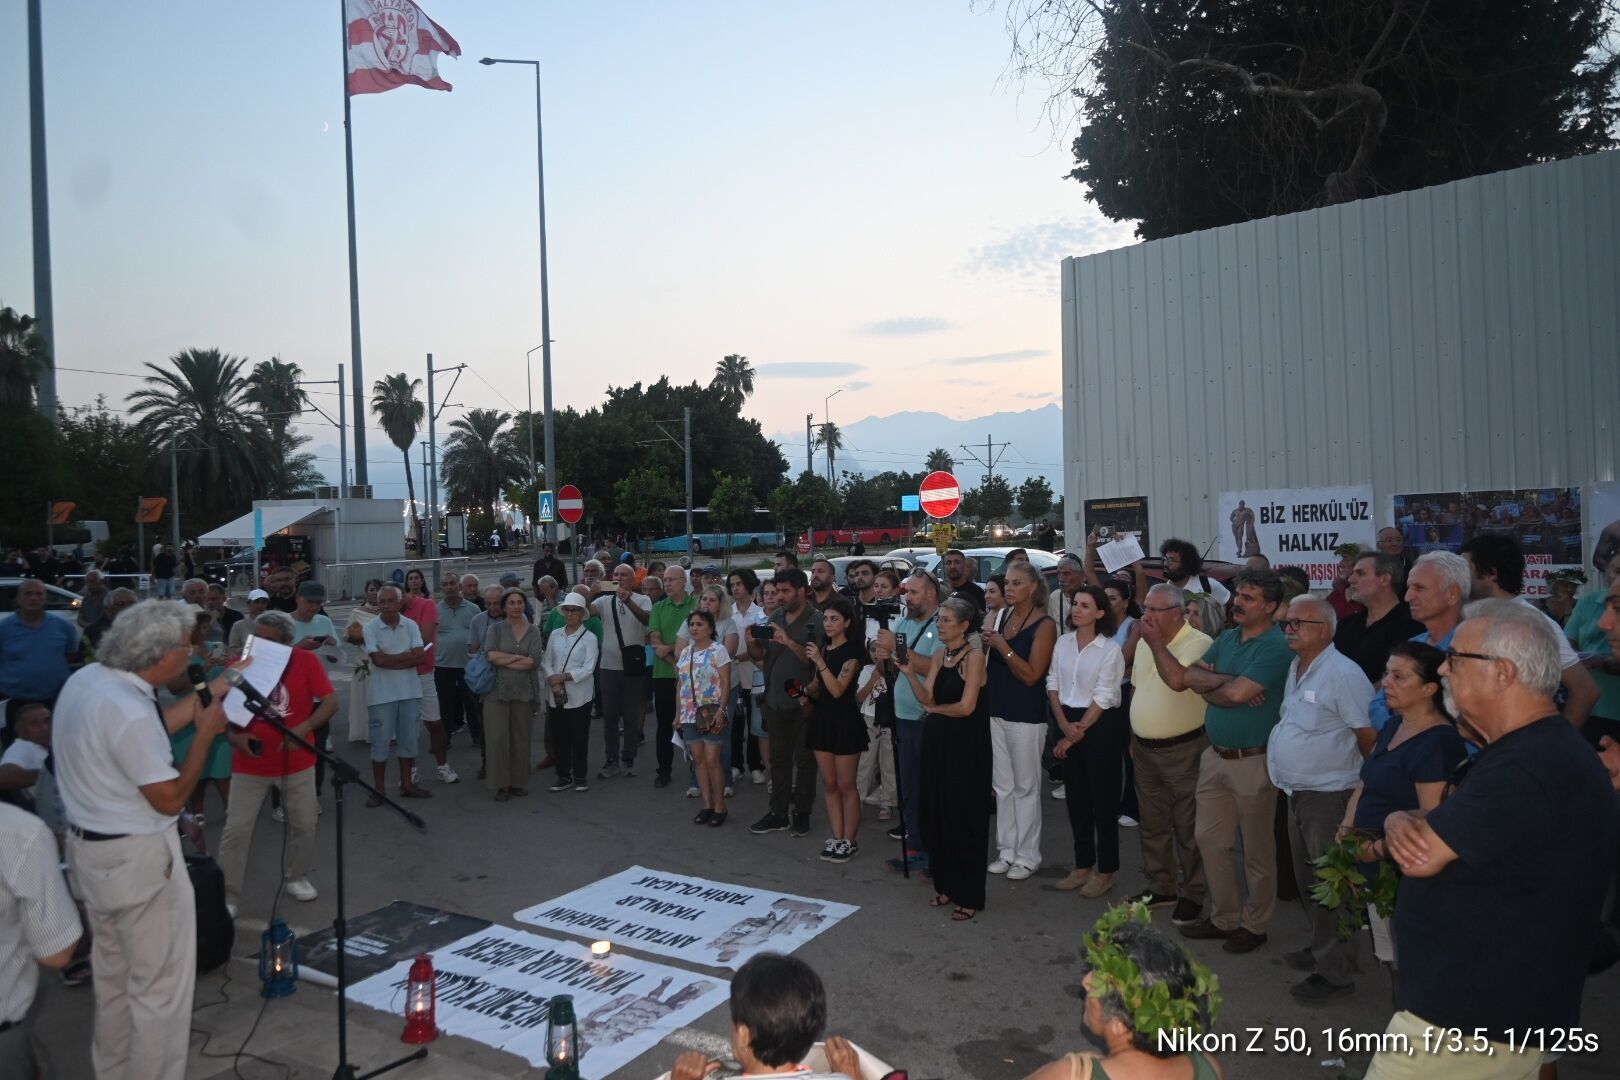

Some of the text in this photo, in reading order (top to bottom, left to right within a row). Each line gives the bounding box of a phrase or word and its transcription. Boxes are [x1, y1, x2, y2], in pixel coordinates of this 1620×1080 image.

[1260, 498, 1369, 524] BİZ HERKÜL'ÜZ
[1278, 532, 1340, 552] HALKIZ
[631, 875, 755, 906] TARİH OLACAK
[615, 894, 707, 922] YIKANLAR
[533, 906, 703, 949] ANTALYA TARİHİNİ
